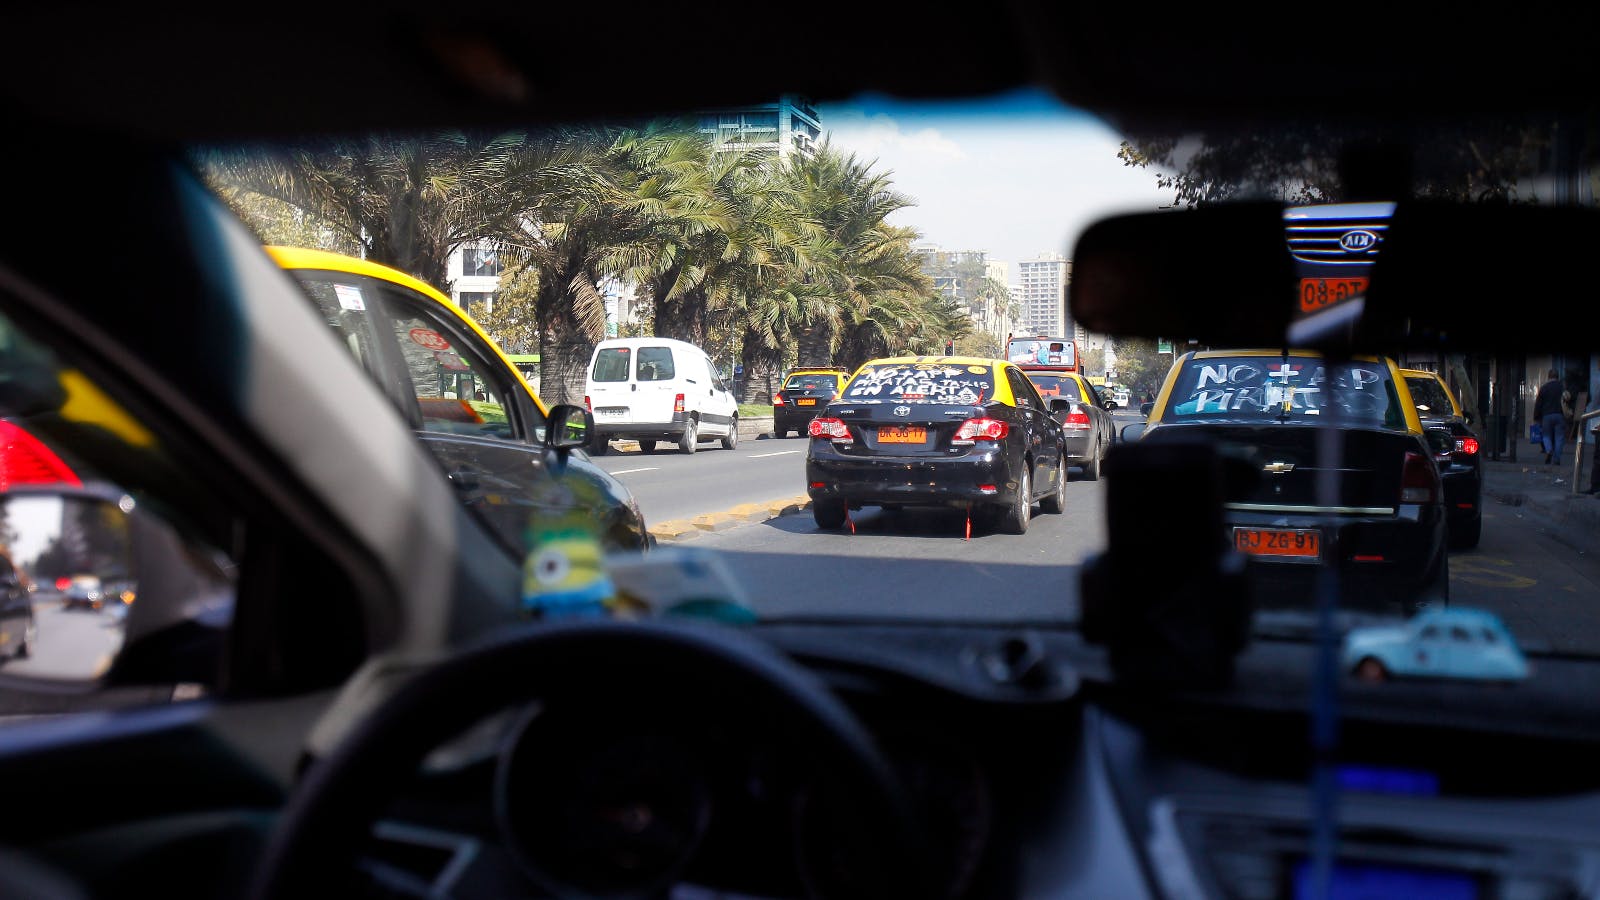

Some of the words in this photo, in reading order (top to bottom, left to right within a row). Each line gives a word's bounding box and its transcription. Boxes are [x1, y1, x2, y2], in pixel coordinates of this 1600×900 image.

[1193, 364, 1260, 390] NO
[1268, 363, 1300, 385] +
[850, 384, 883, 396] EN
